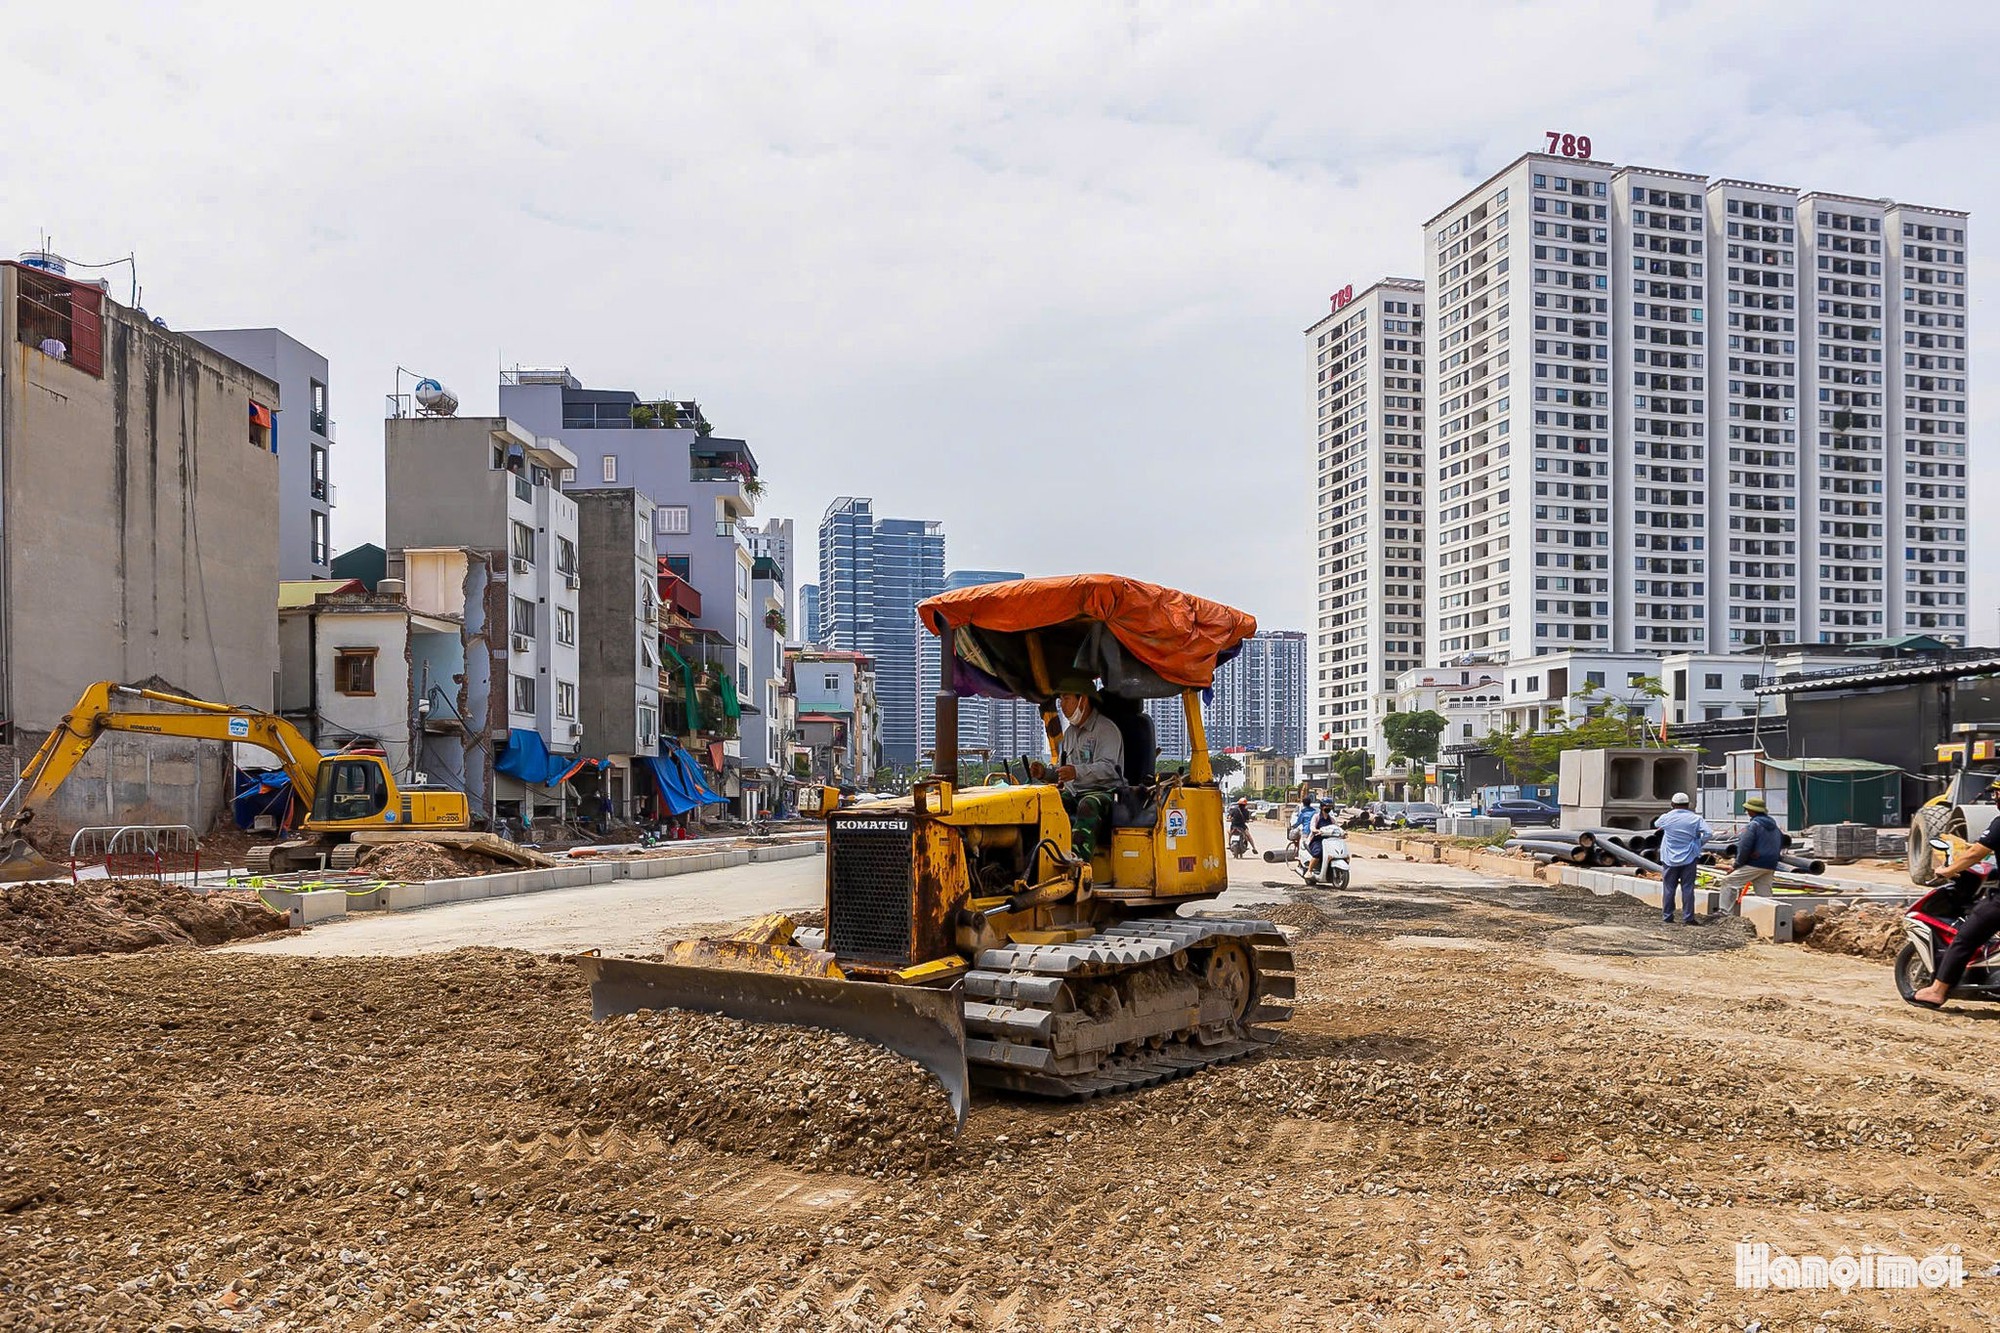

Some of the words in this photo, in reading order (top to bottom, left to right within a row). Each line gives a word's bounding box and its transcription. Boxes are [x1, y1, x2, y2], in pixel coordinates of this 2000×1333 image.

[1546, 131, 1592, 159] 789
[1330, 284, 1353, 313] 789
[836, 820, 908, 831] KOMATSU
